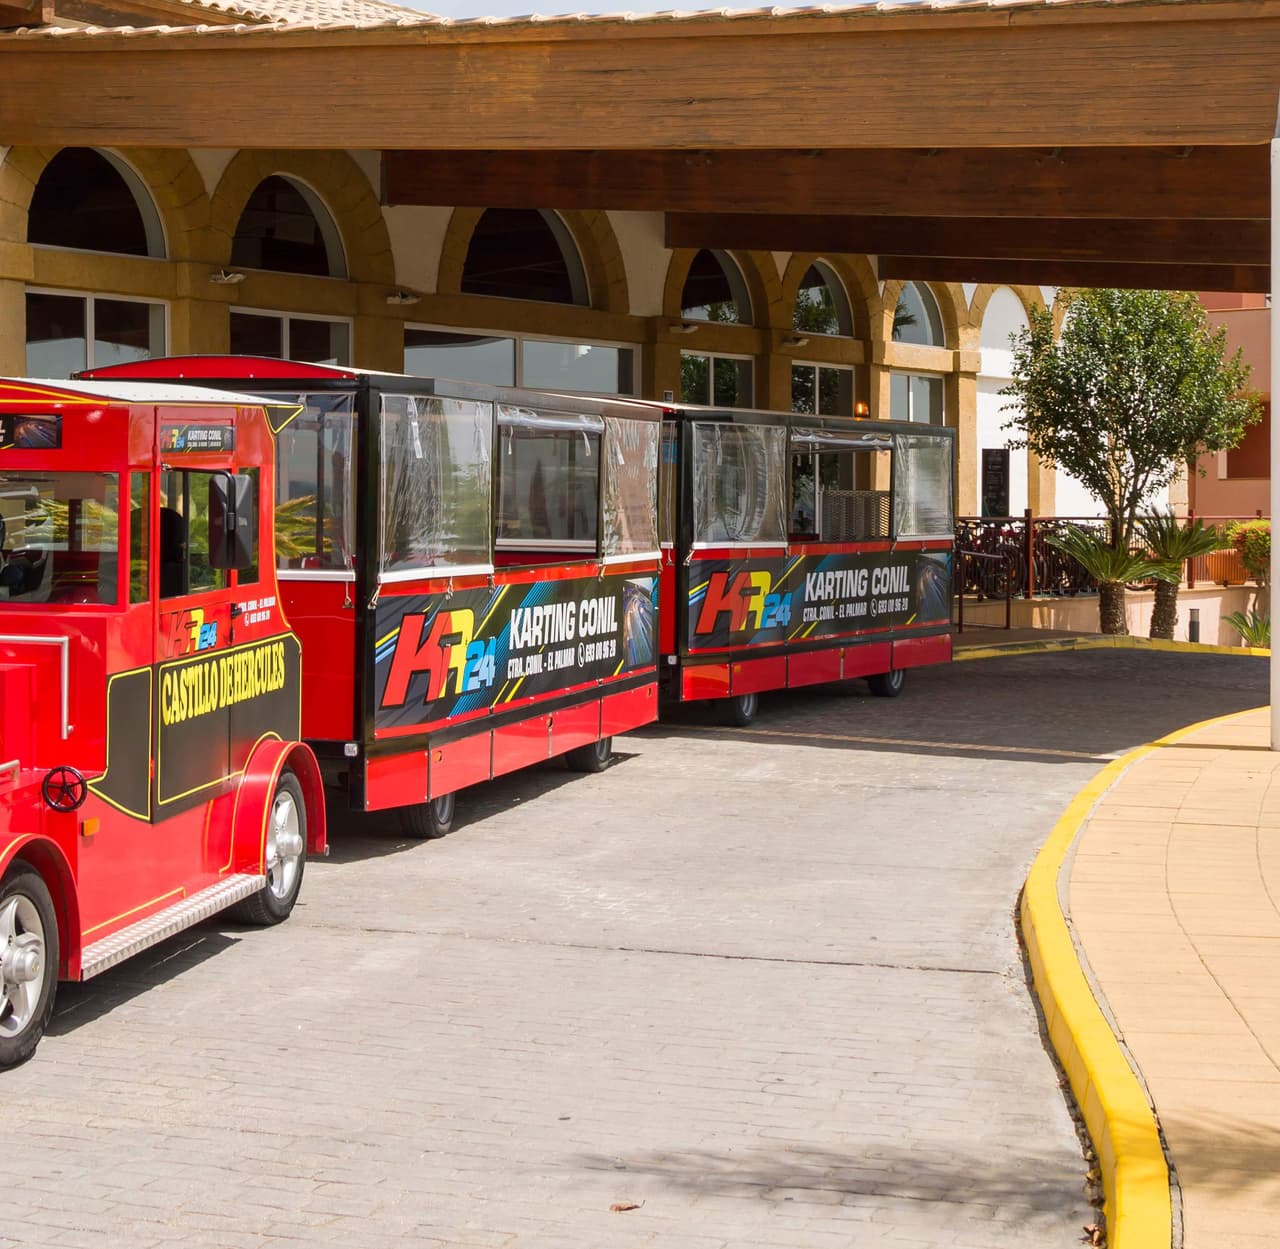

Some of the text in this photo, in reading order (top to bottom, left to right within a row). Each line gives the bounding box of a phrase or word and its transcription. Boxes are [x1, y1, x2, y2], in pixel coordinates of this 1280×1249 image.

[804, 565, 910, 602] KARTING CONIL
[509, 595, 618, 651] KARTING CONIL
[819, 605, 835, 621] CONIL
[839, 604, 845, 618] EL
[846, 602, 868, 617] PALMAR
[525, 653, 543, 676] CONIL
[547, 651, 554, 671] EL
[554, 647, 576, 670] PALMAR
[161, 659, 219, 726] CASTILLO
